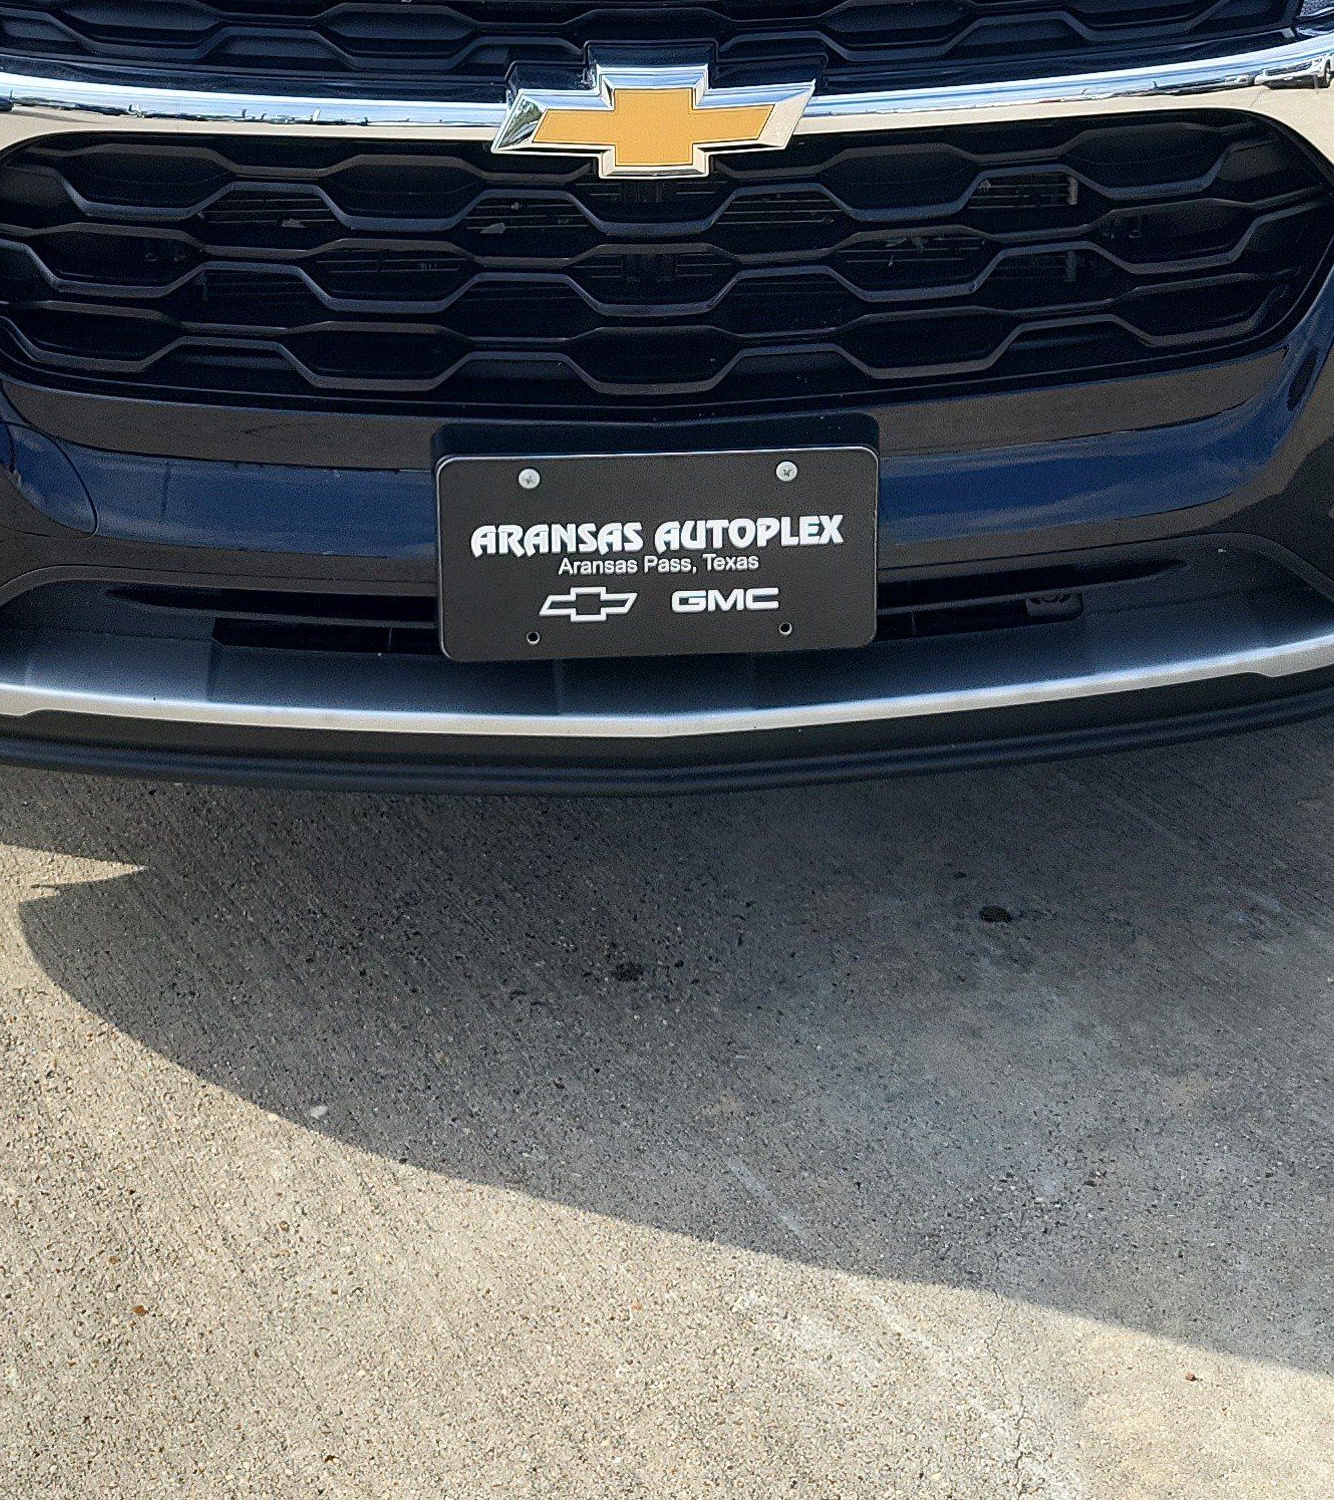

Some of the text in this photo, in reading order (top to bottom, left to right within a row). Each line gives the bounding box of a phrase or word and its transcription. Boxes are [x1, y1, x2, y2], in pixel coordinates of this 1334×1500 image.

[470, 514, 845, 558] ARANSAS AUTOPLEX
[558, 553, 760, 576] Aransas Pass, Texas
[671, 587, 779, 613] GMC
